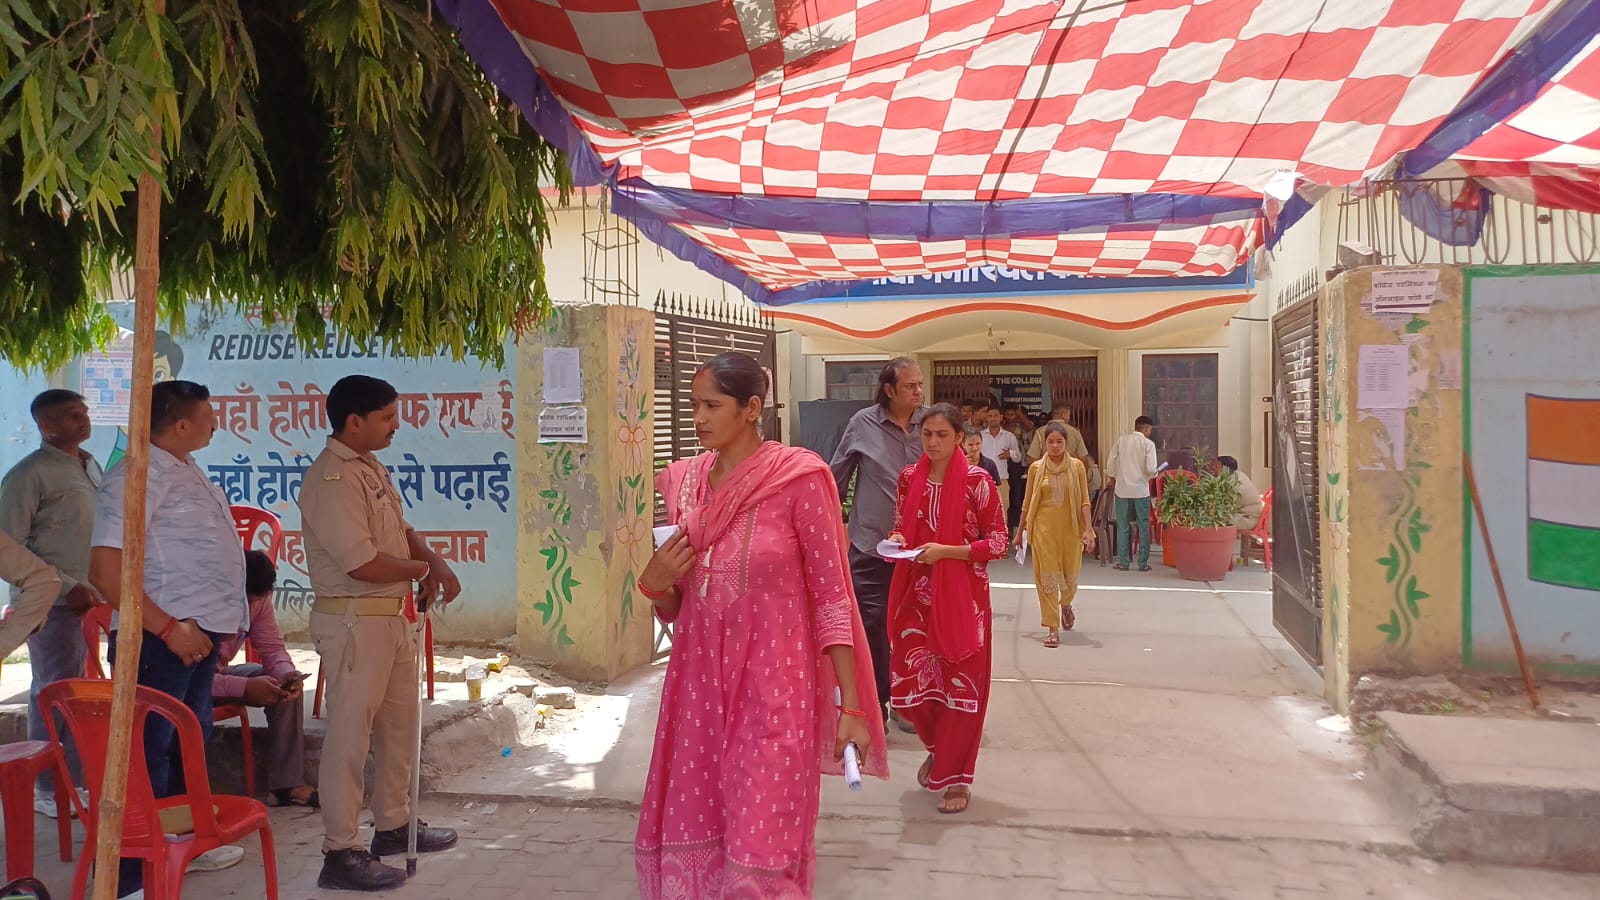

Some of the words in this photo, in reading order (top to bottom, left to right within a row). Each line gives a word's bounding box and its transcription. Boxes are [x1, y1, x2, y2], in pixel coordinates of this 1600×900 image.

[208, 334, 296, 361] REDUSE
[398, 453, 426, 509] से
[430, 451, 513, 513] पढ़ाई
